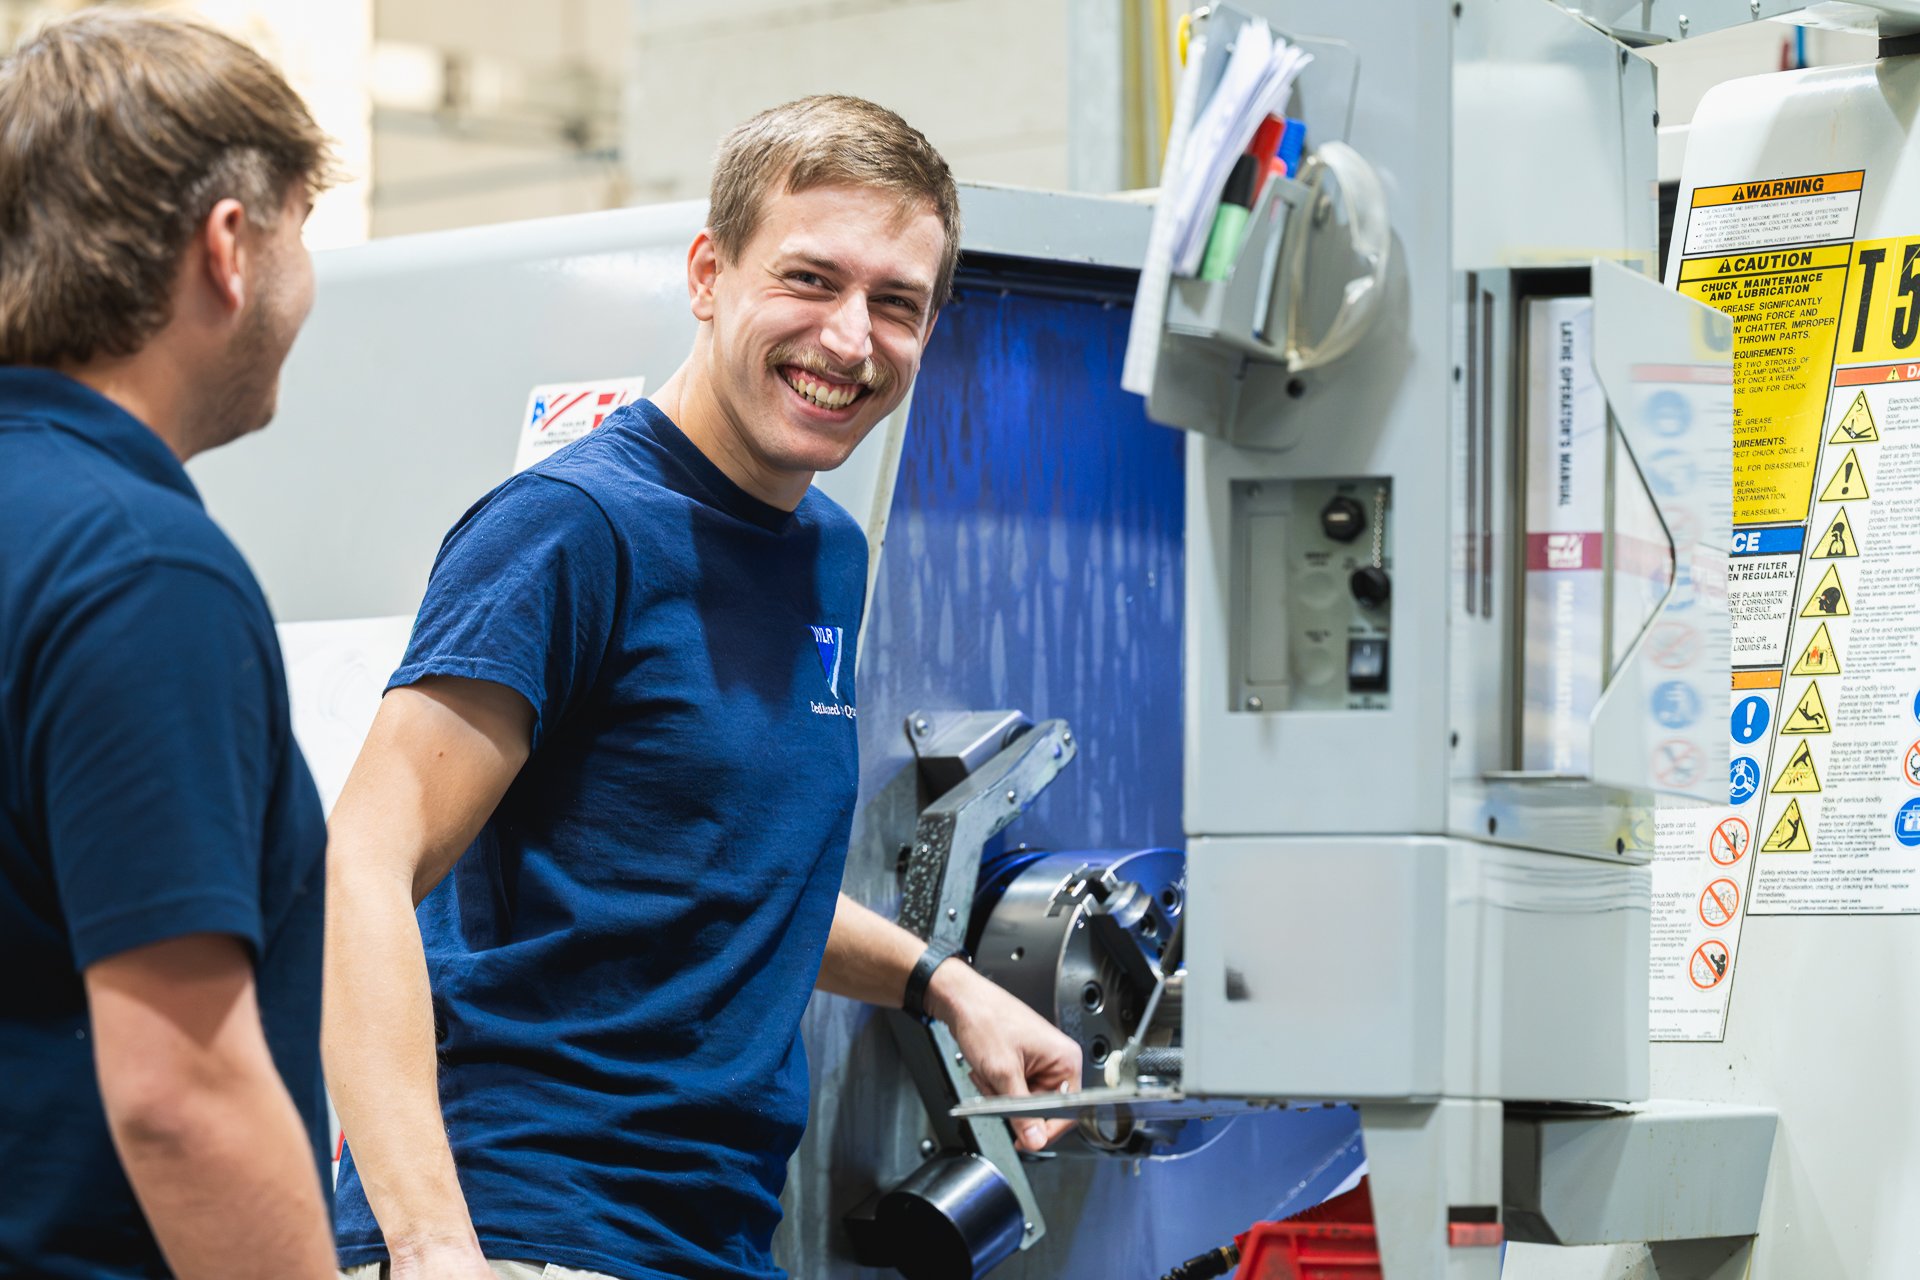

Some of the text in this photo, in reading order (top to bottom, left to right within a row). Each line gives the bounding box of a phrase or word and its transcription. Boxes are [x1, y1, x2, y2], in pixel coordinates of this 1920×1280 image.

[1746, 177, 1825, 199] WARNING
[1733, 251, 1812, 272] CAUTION
[1701, 272, 1824, 293] CHUCK MAINTENANCE
[1709, 284, 1810, 302] AND LUBRICATION
[1720, 296, 1823, 314] GREASE SIGNIFICANTLY
[1766, 310, 1796, 320] FORCE
[1799, 308, 1818, 317] AND
[1792, 317, 1835, 328] IMPROPER
[1738, 334, 1776, 344] THROWN
[1733, 346, 1796, 360] EQUIREMENTS:
[1746, 360, 1762, 368] TWO
[1764, 358, 1798, 367] STROKES
[1800, 356, 1810, 364] OF
[1748, 376, 1767, 384] ONCE
[1749, 386, 1764, 394] GUN
[1766, 384, 1781, 392] FOR
[1783, 382, 1808, 390] CHUCK
[1558, 320, 1574, 507] LATHE OPERATOR'S MANUAL
[1745, 416, 1773, 426] GREASE
[1751, 448, 1776, 458] CHUCK
[1778, 447, 1798, 455] ONCE
[1747, 464, 1762, 472] FOR
[1764, 461, 1811, 472] DISASSEMBLY
[1738, 563, 1755, 572] THE
[1757, 562, 1788, 571] FILTER
[1742, 570, 1796, 581] REGULARLY.
[1742, 598, 1784, 606] CORROSION
[1753, 612, 1787, 621] COOLANT
[1735, 636, 1756, 644] TOXIC
[1734, 644, 1761, 652] LIQUIDS
